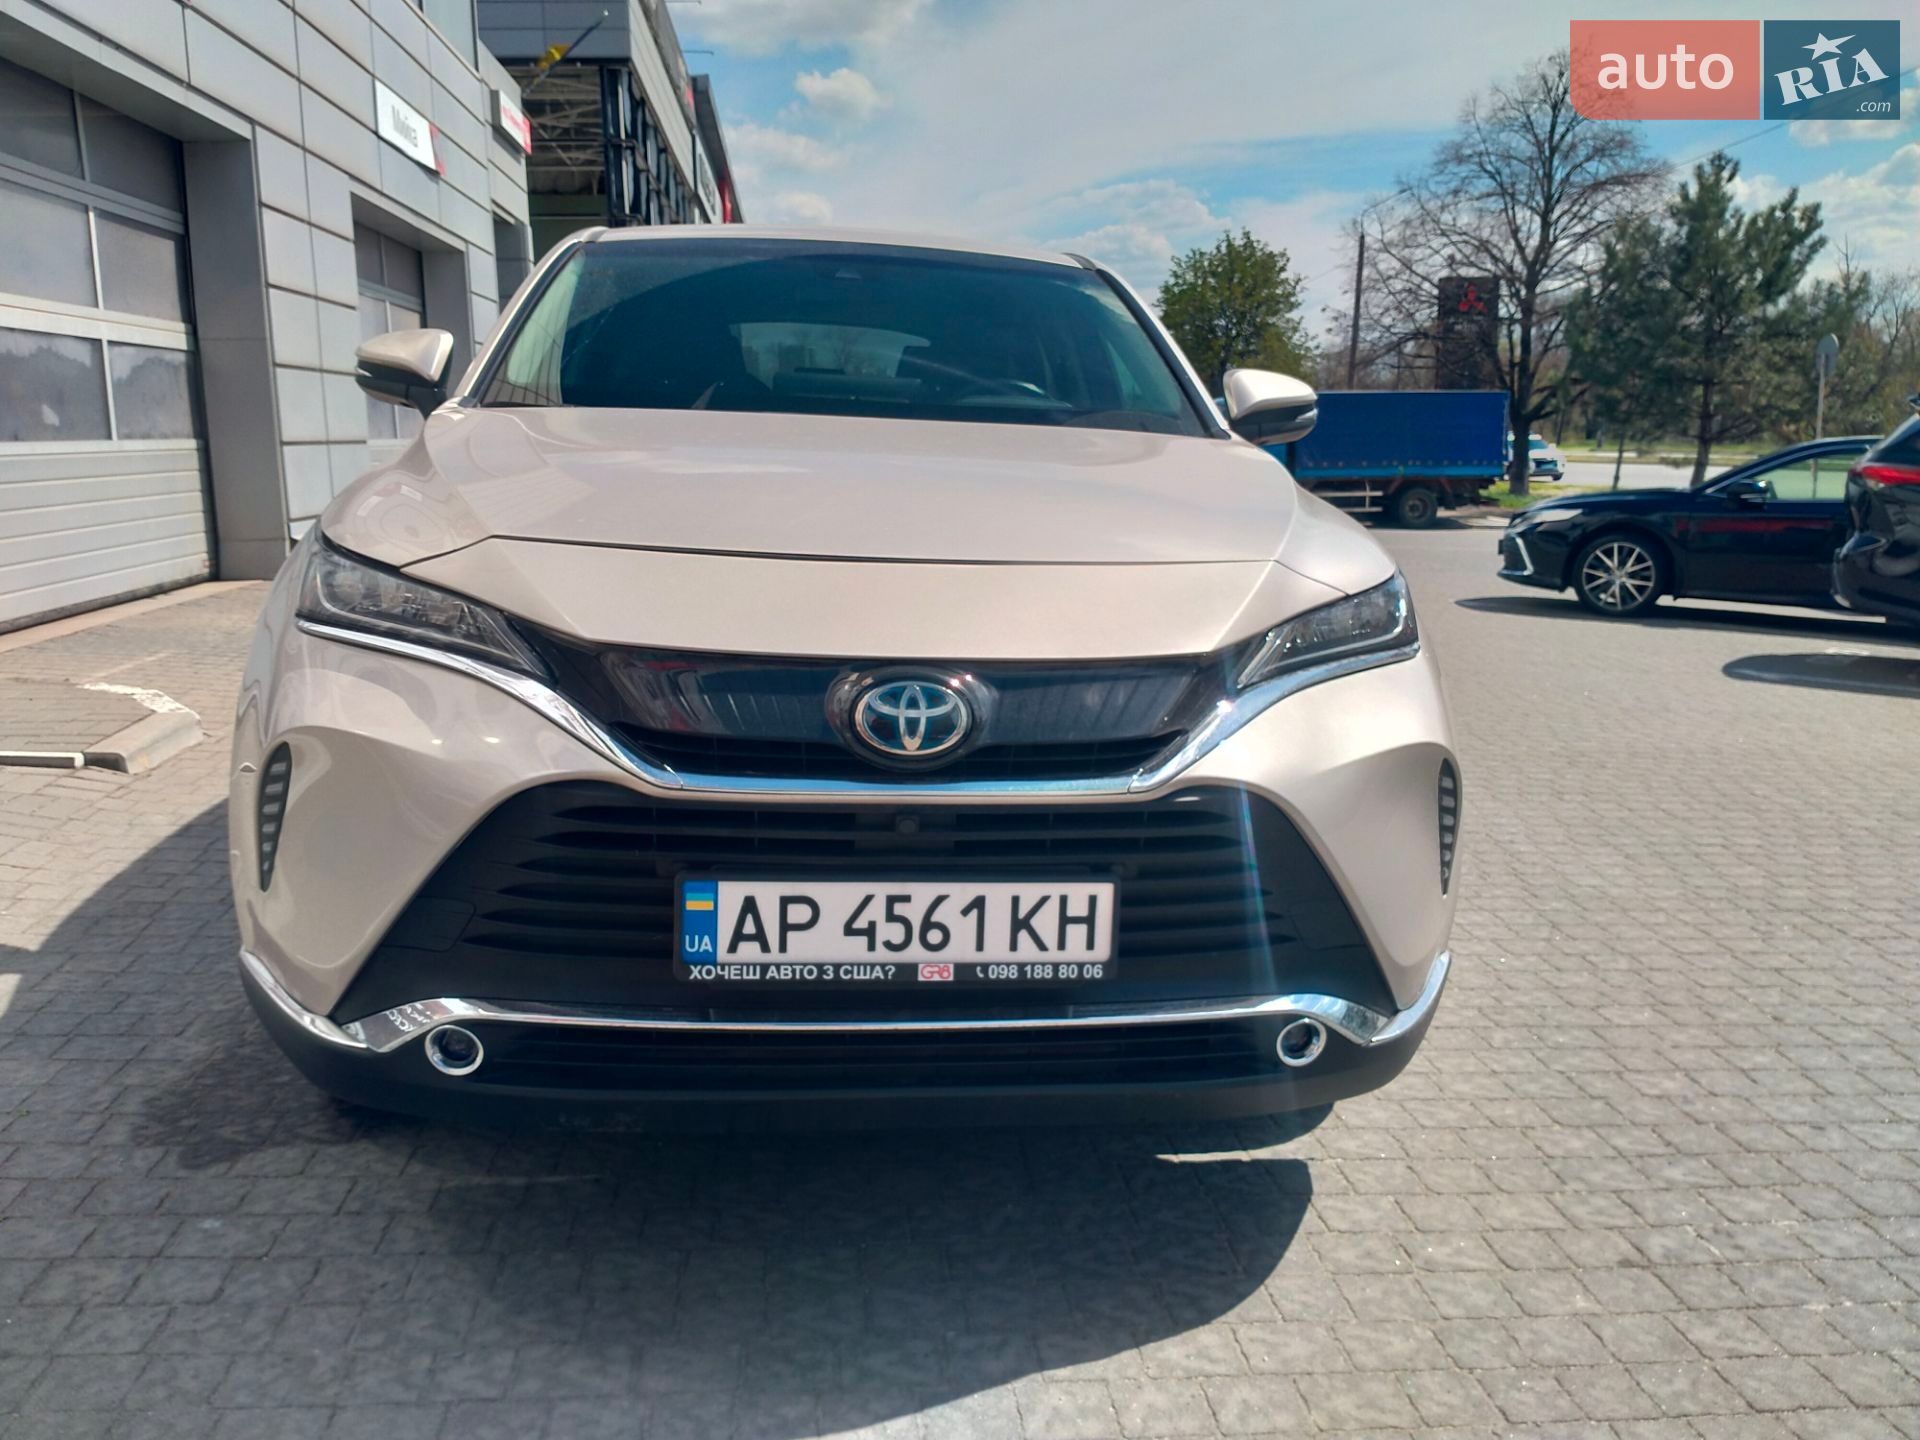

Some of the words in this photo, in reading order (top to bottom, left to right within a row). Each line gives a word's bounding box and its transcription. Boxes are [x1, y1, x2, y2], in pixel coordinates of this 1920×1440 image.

[726, 895, 821, 954] AP
[843, 894, 986, 953] 4561
[1009, 894, 1098, 952] KH
[685, 935, 713, 953] UA
[689, 965, 760, 980] ХОЧЕШ
[765, 965, 817, 980] АВТО
[839, 965, 896, 980] США?
[988, 964, 1018, 979] 098
[1024, 964, 1053, 979] 188
[1058, 964, 1078, 979] 80
[1083, 964, 1104, 979] 06
